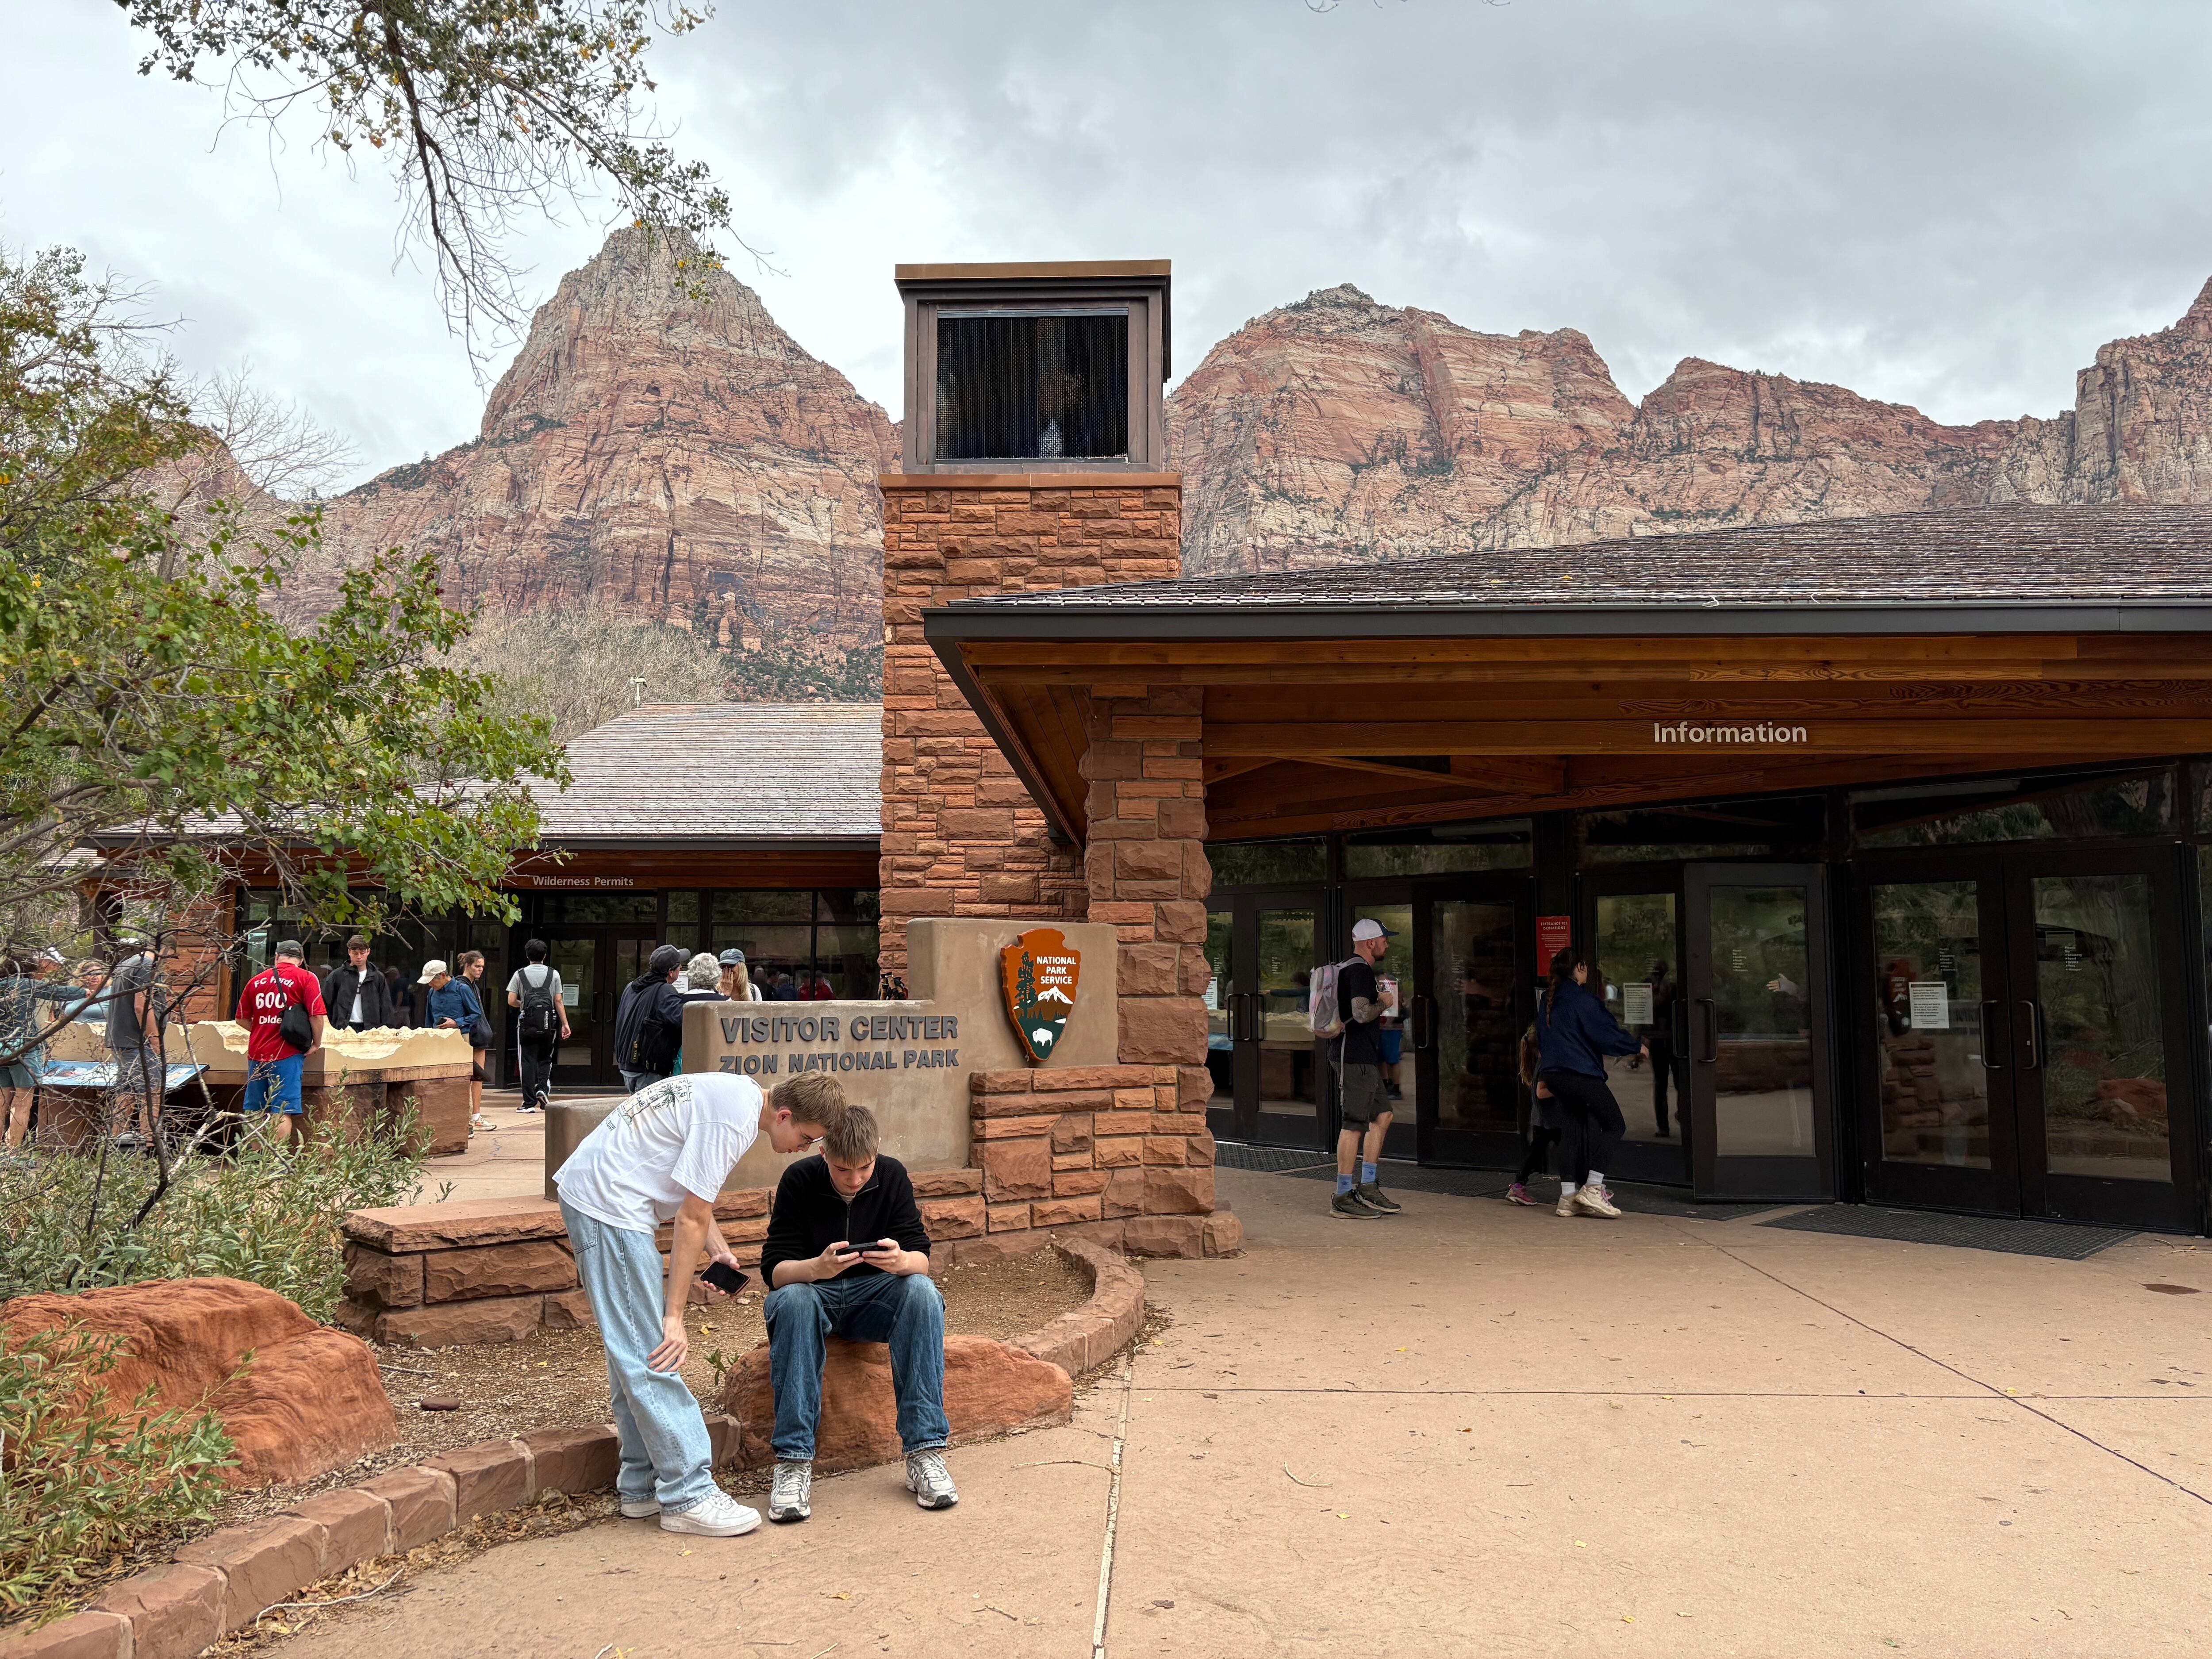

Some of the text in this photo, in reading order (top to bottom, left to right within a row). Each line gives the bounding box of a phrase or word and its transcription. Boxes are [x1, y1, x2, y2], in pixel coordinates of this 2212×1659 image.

[1653, 722, 1807, 742] Information
[533, 876, 634, 886] Wilderness Permits
[1037, 956, 1077, 964] NATIONAL
[254, 977, 267, 988] FC
[1041, 975, 1072, 984] SERVICE
[255, 991, 287, 1009] 600
[720, 1016, 958, 1043] VISITOR CENTER
[719, 1049, 959, 1074] ZION NATIONAL PARK
